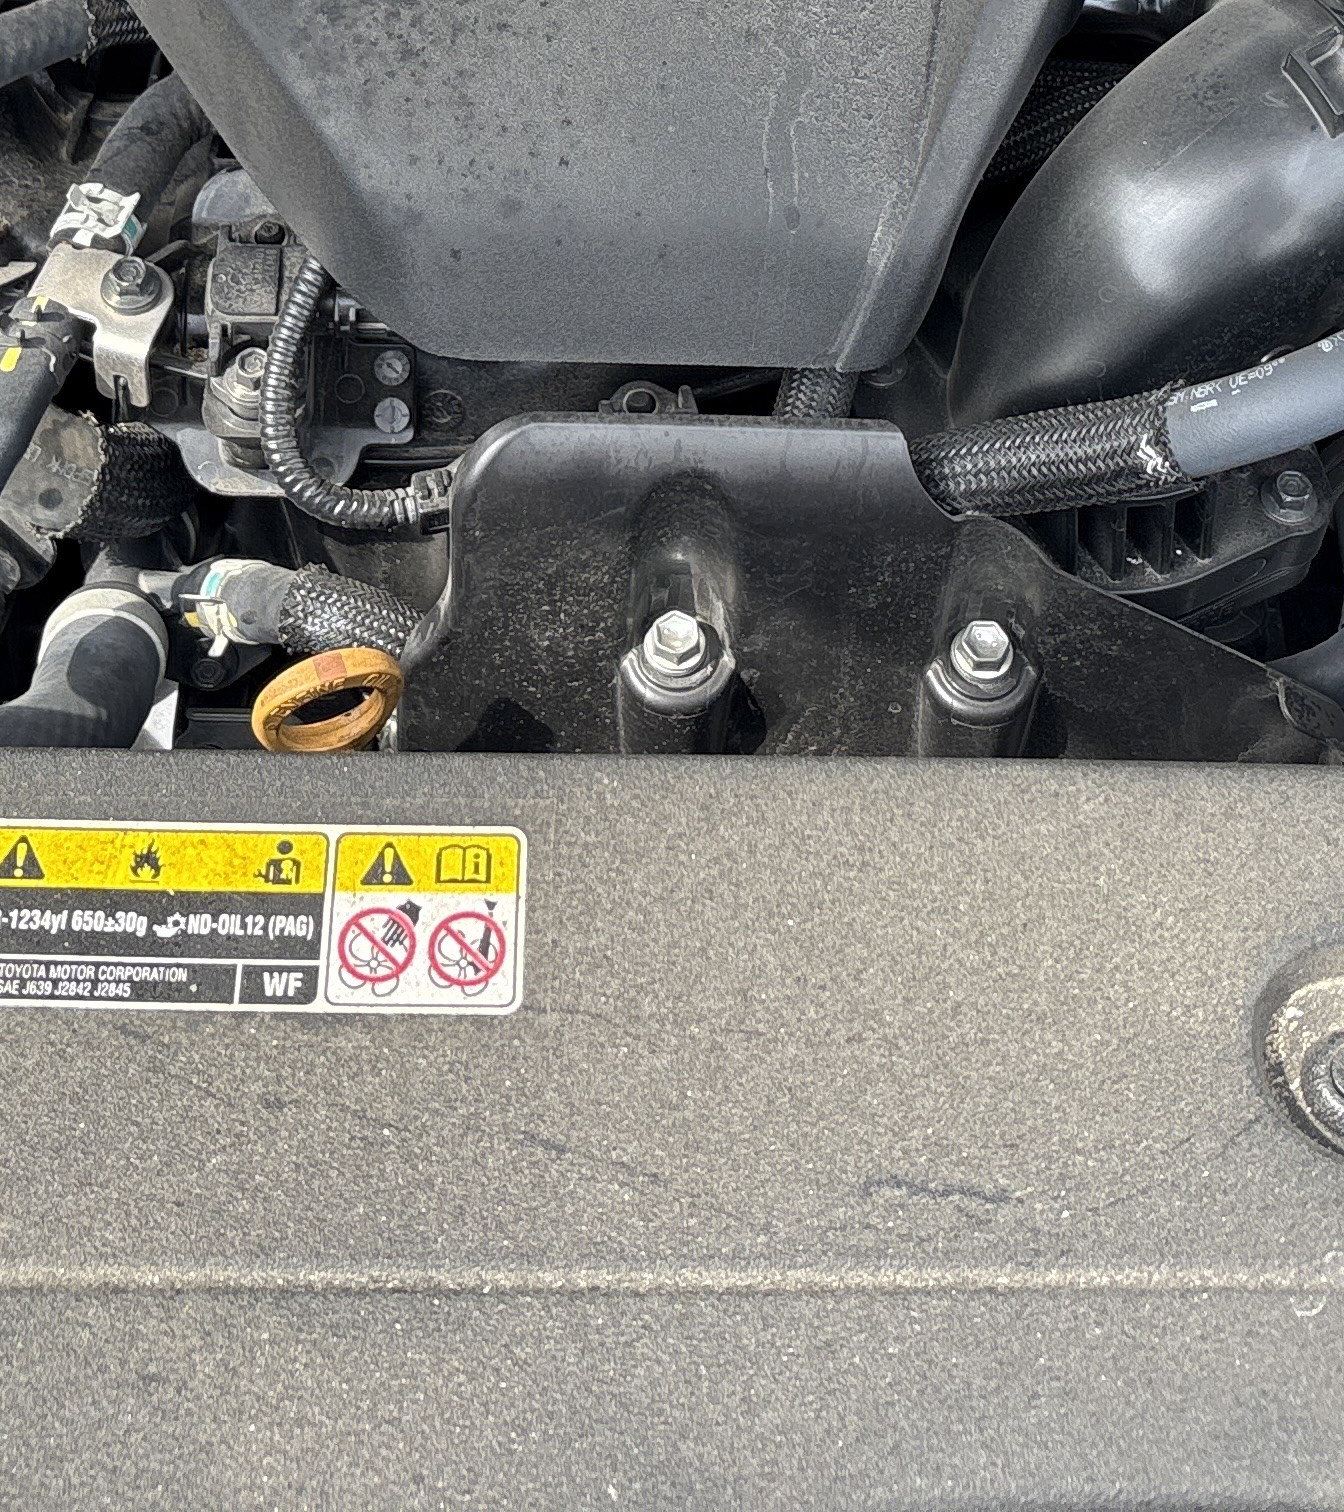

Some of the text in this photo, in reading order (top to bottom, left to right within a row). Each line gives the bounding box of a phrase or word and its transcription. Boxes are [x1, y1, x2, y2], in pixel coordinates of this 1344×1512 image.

[71, 910, 148, 937] 650±30g
[187, 913, 265, 938] ND-OIL12
[267, 915, 315, 941] (PAG)
[50, 964, 94, 980] MOTOR
[97, 965, 188, 982] CORPORATION
[21, 980, 52, 996] J639
[53, 981, 91, 997] J2842
[93, 982, 131, 998] J2845
[263, 972, 303, 997] WF
